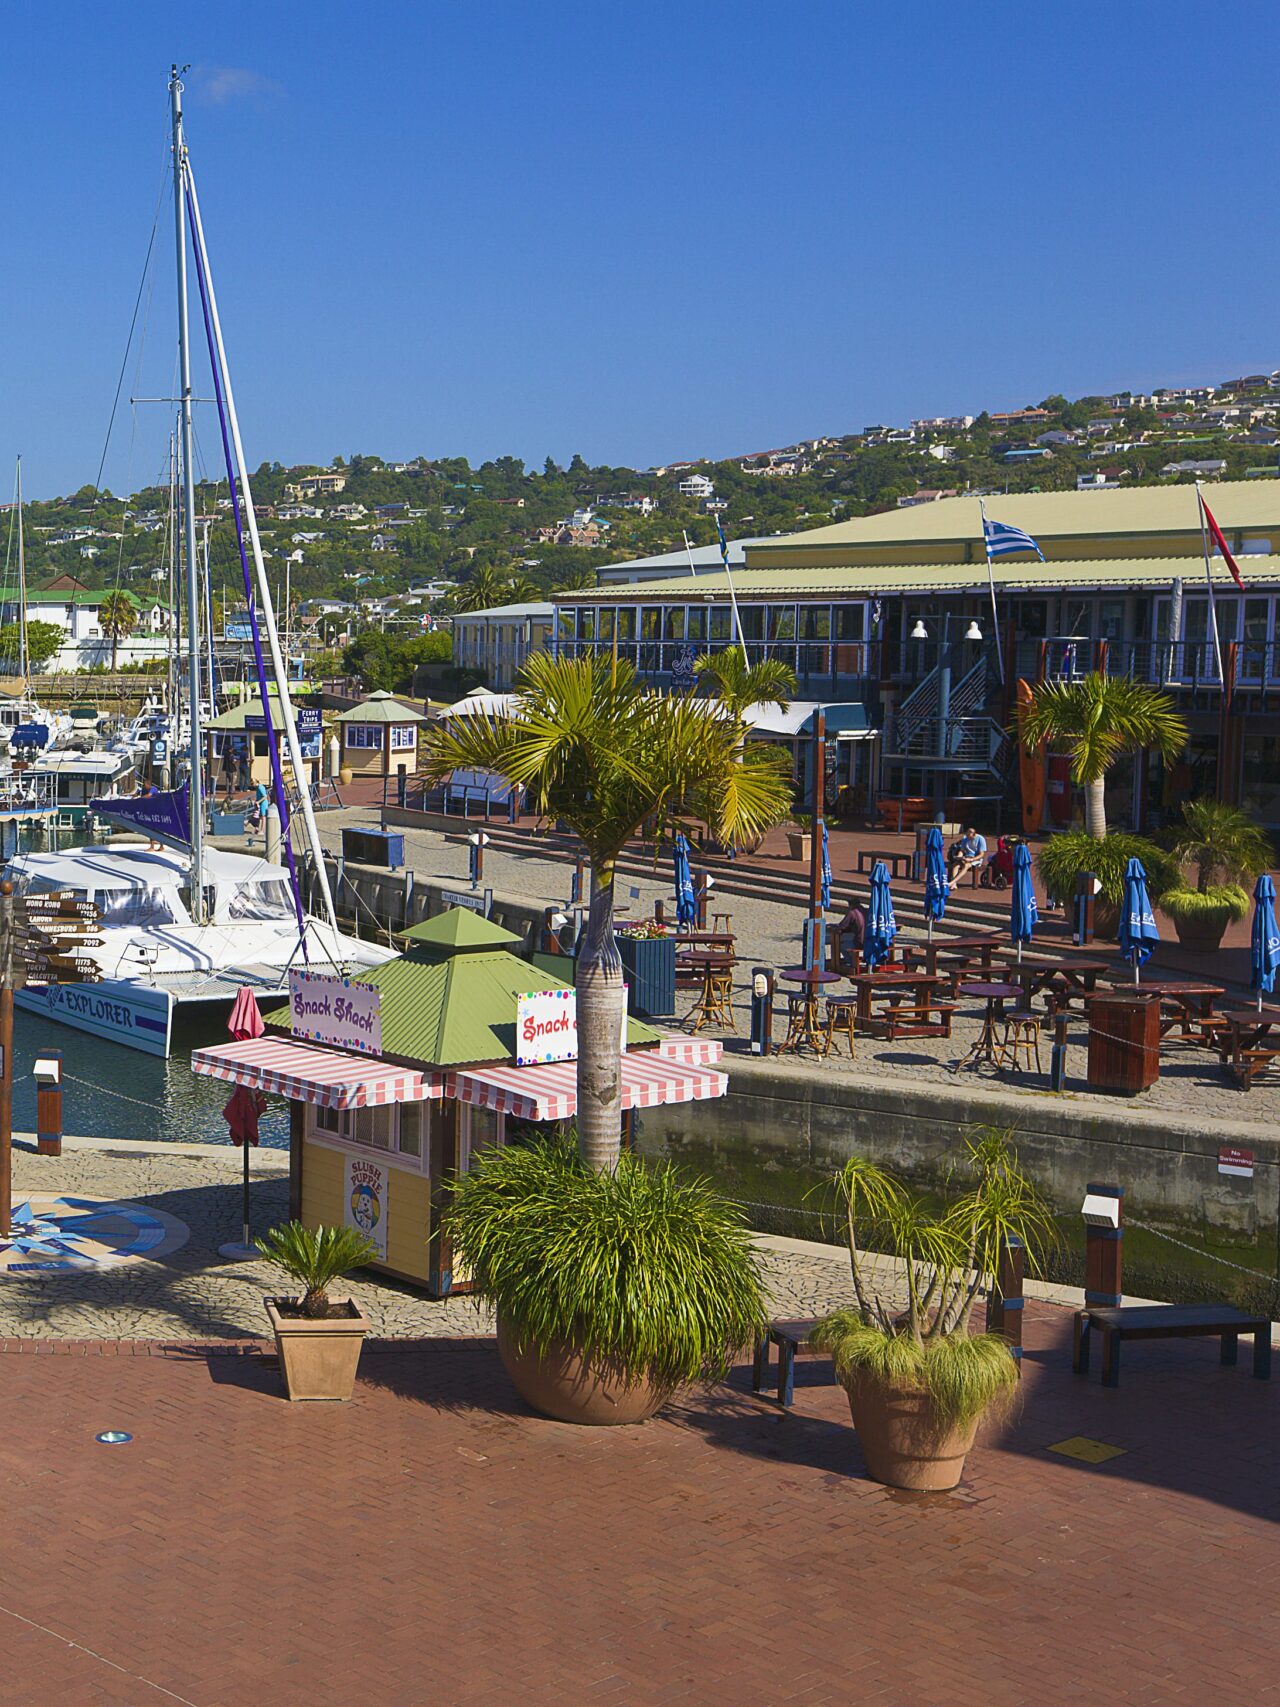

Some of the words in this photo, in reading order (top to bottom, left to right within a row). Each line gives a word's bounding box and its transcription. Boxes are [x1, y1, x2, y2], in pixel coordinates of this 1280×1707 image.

[303, 716, 318, 724] TRIPS
[43, 900, 61, 909] KONG
[66, 990, 132, 1028] EXPLORER
[294, 992, 331, 1018] Snack
[333, 997, 374, 1033] Shack
[523, 1010, 569, 1043] Snack
[351, 1160, 382, 1181] SLUSH
[350, 1172, 383, 1195] PUPPIE
